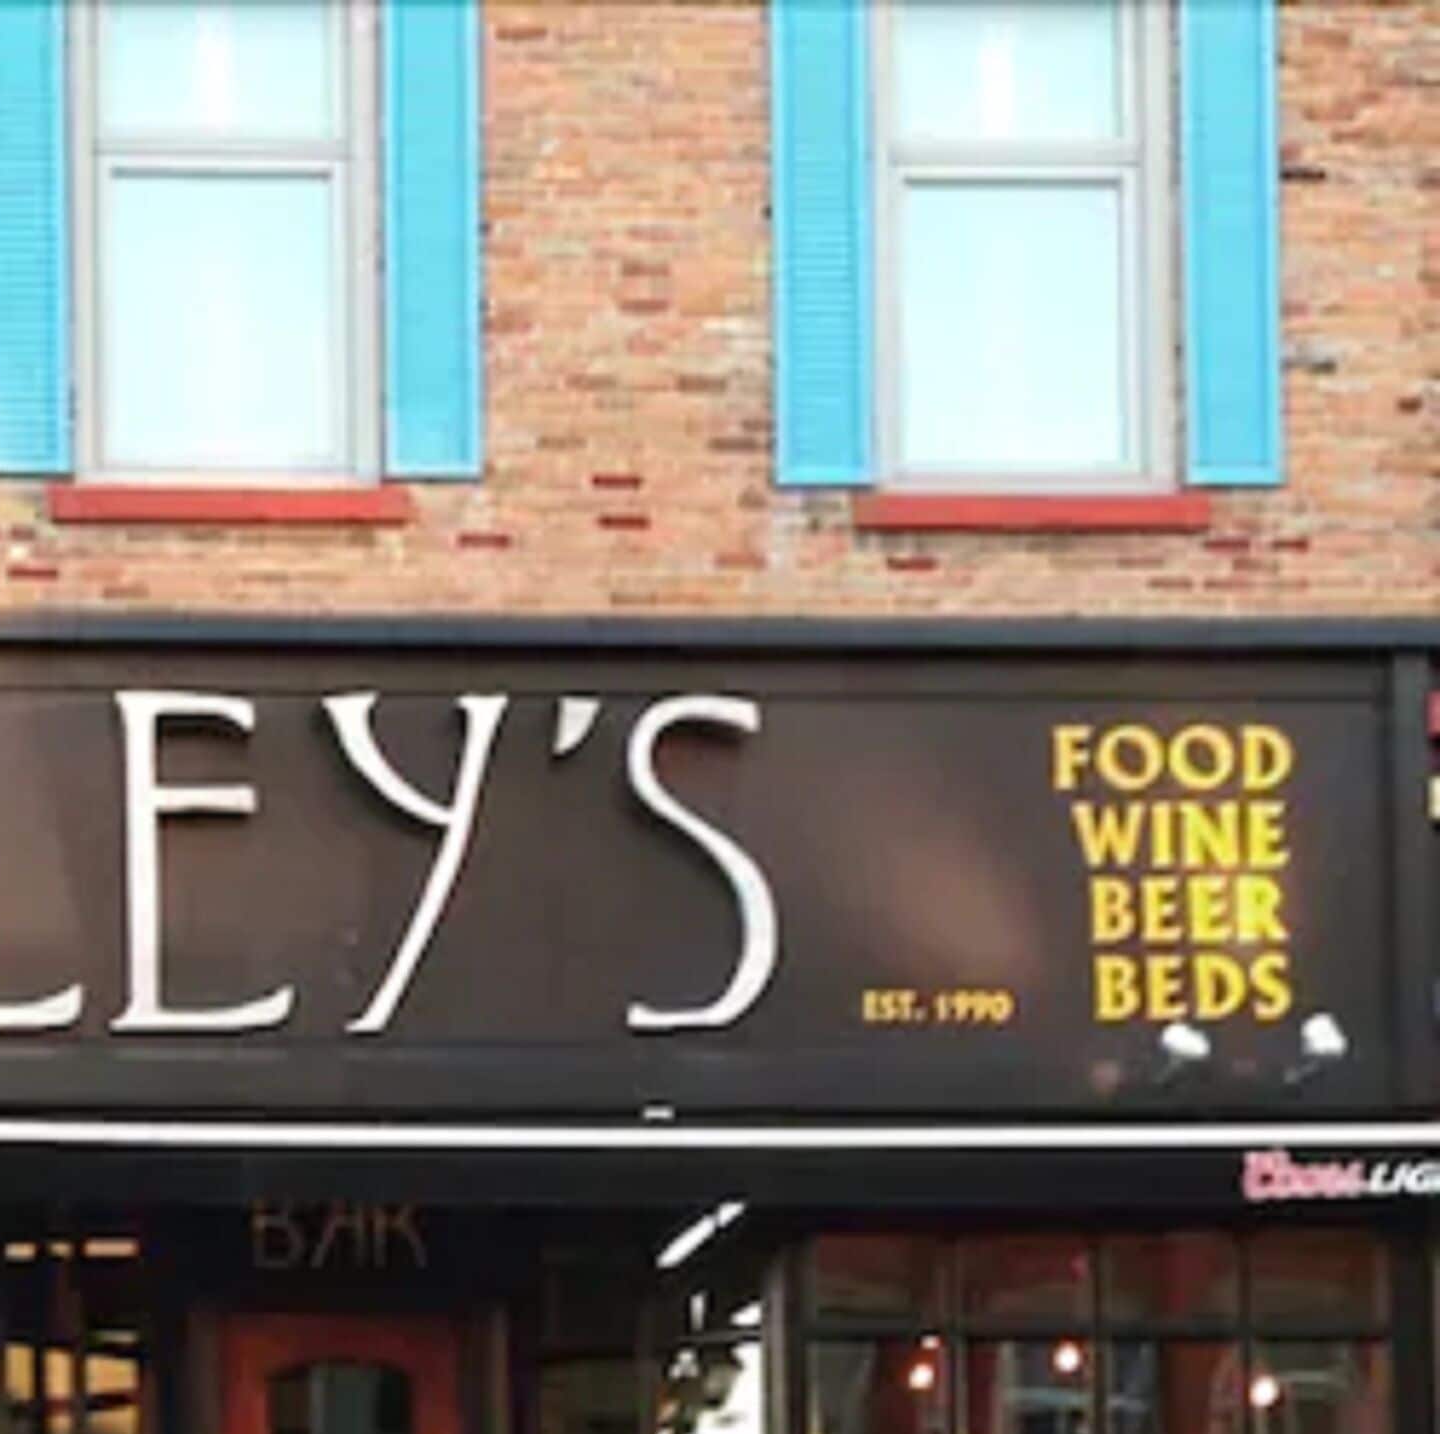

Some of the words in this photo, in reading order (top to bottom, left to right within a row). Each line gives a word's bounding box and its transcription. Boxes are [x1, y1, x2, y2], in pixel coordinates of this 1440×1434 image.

[1050, 724, 1295, 791] FOOD
[1071, 801, 1291, 869] WINE
[1089, 875, 1289, 944] BEER
[862, 989, 926, 1022] EST.
[934, 988, 1015, 1022] 1990
[1093, 953, 1294, 1022] BEDS
